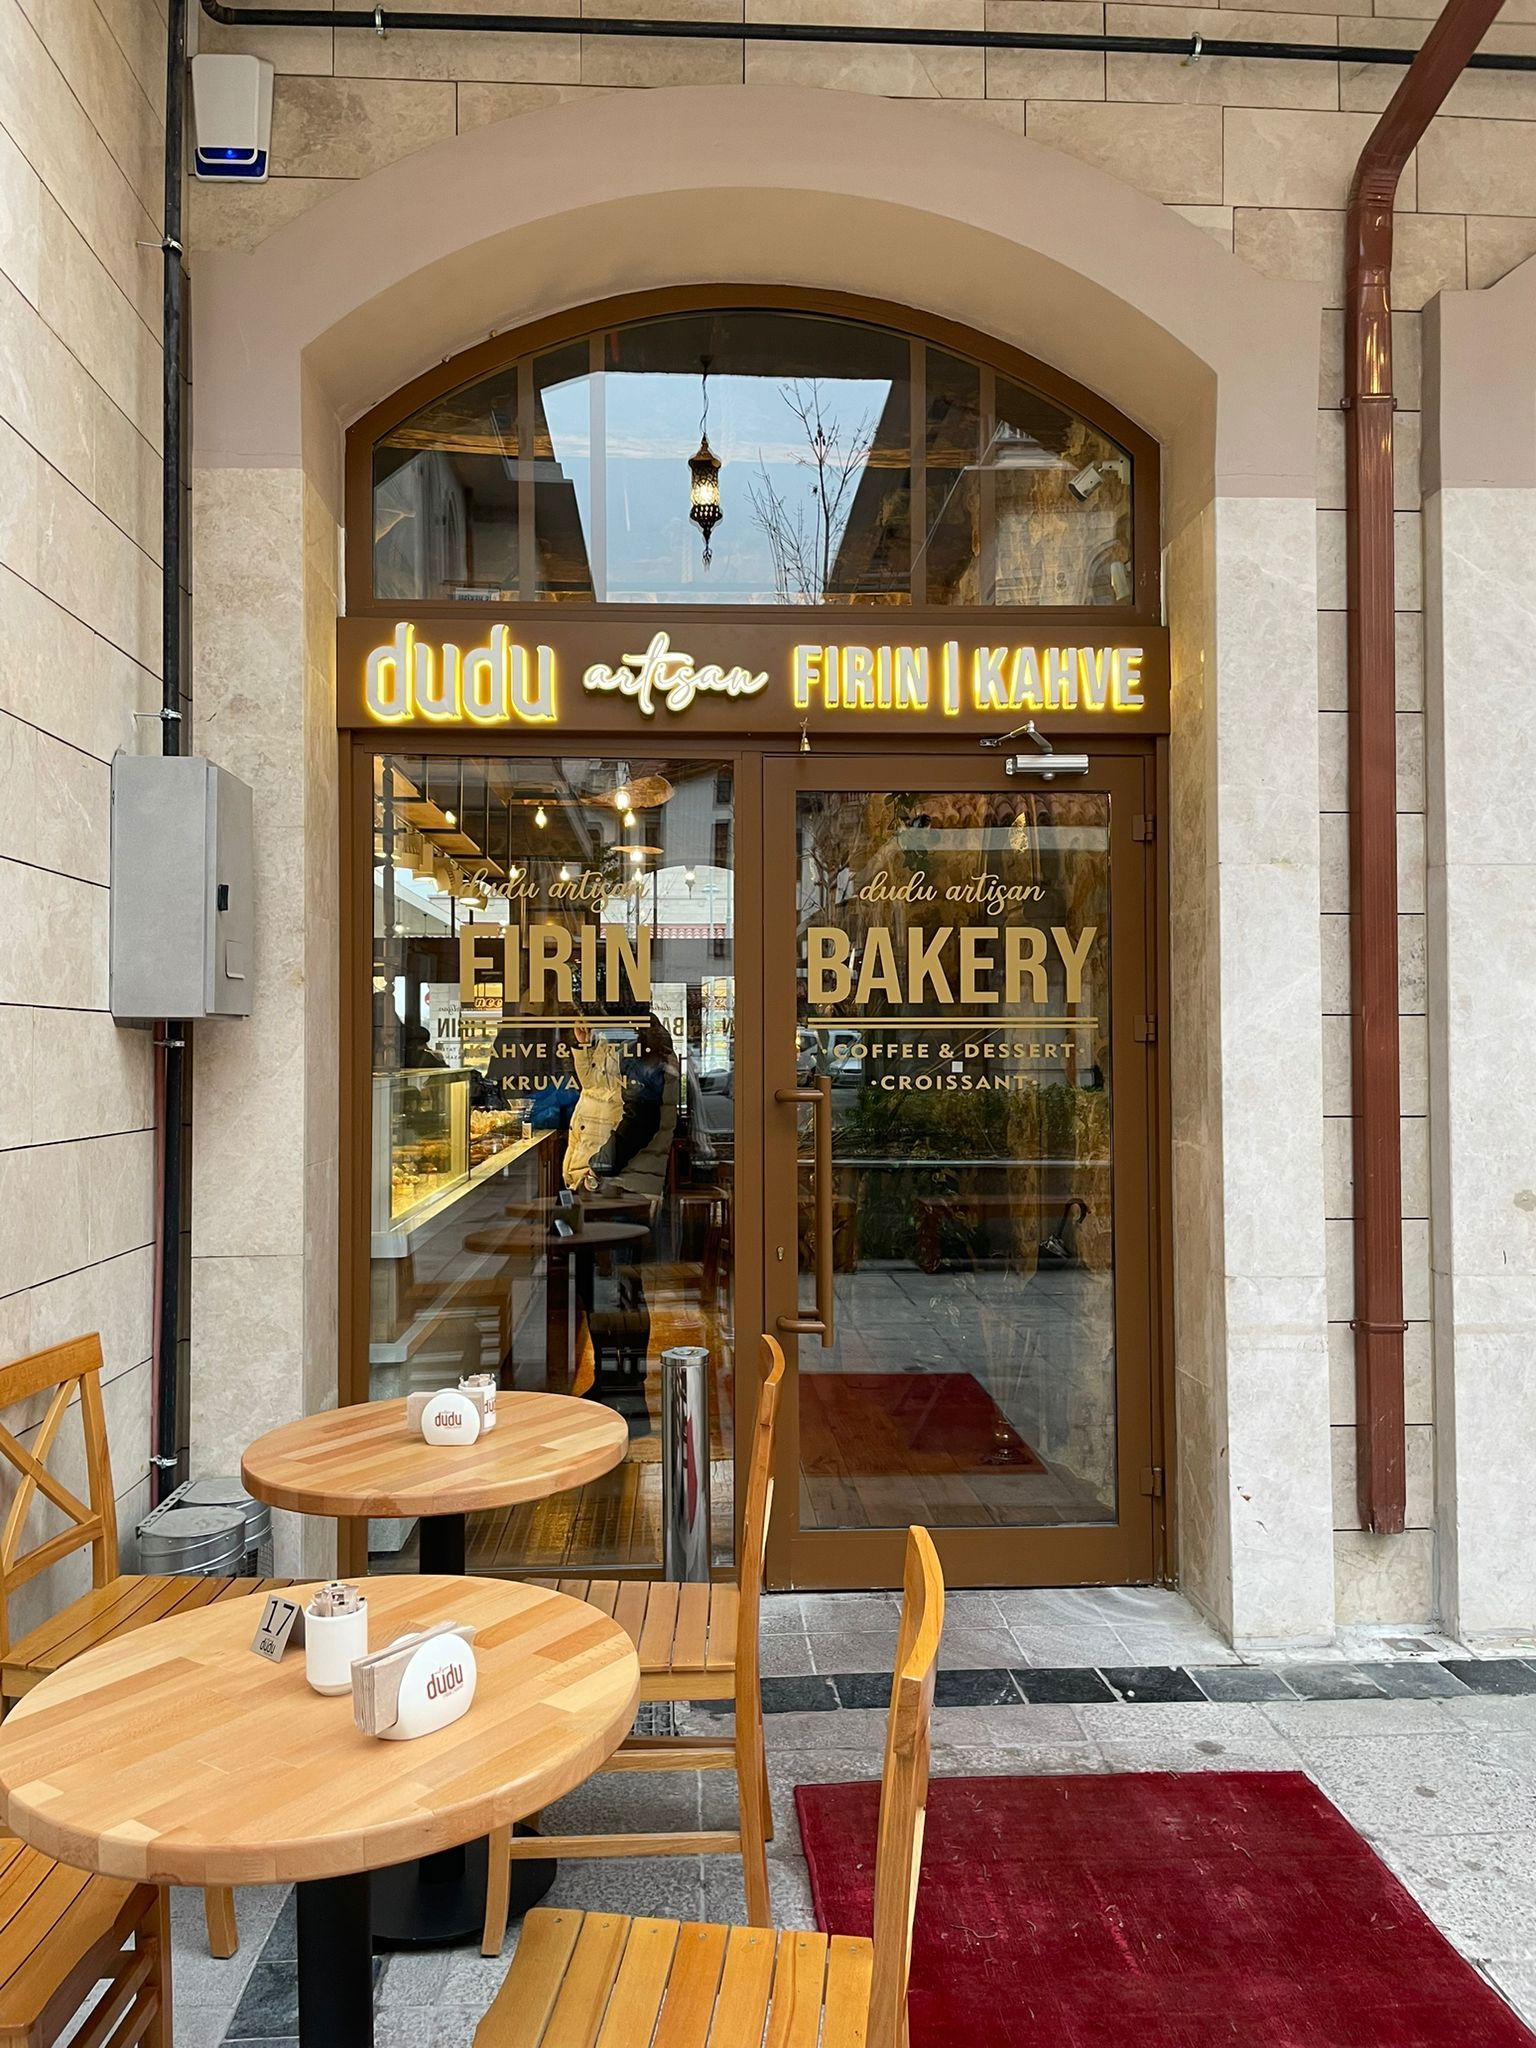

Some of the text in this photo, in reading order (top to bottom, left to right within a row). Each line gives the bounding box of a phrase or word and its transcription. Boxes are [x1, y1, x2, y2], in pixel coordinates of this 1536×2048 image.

[366, 622, 557, 722] dudu
[583, 631, 769, 716] artisan
[794, 645, 929, 709] FIRIN
[975, 646, 1144, 711] KAHVE
[459, 867, 651, 914] dudu artisan
[858, 871, 1046, 916] dudu artisan
[459, 924, 651, 1003] FIRIN
[807, 926, 1098, 1004] BAKERY
[556, 1042, 570, 1059] &
[833, 1043, 1076, 1060] COFFEE & DESSERT
[434, 1411, 462, 1427] dudu
[262, 1600, 295, 1636] 17
[427, 1664, 463, 1700] dudu
